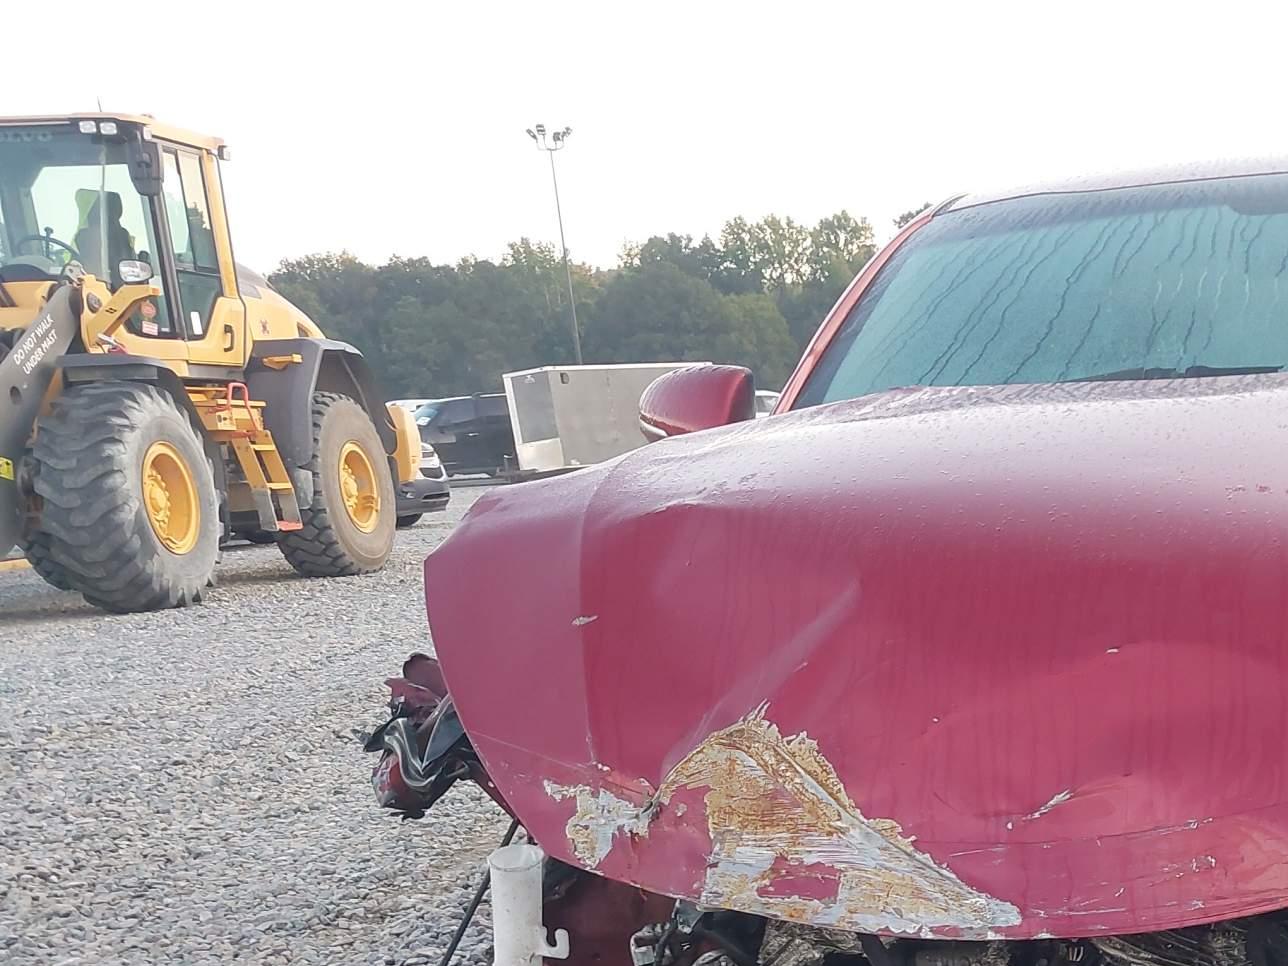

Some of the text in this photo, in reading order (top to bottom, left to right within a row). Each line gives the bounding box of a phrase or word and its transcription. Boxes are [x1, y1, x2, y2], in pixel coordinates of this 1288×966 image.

[13, 313, 54, 365] DO NOT WALK
[22, 328, 58, 375] UNDER MAST
